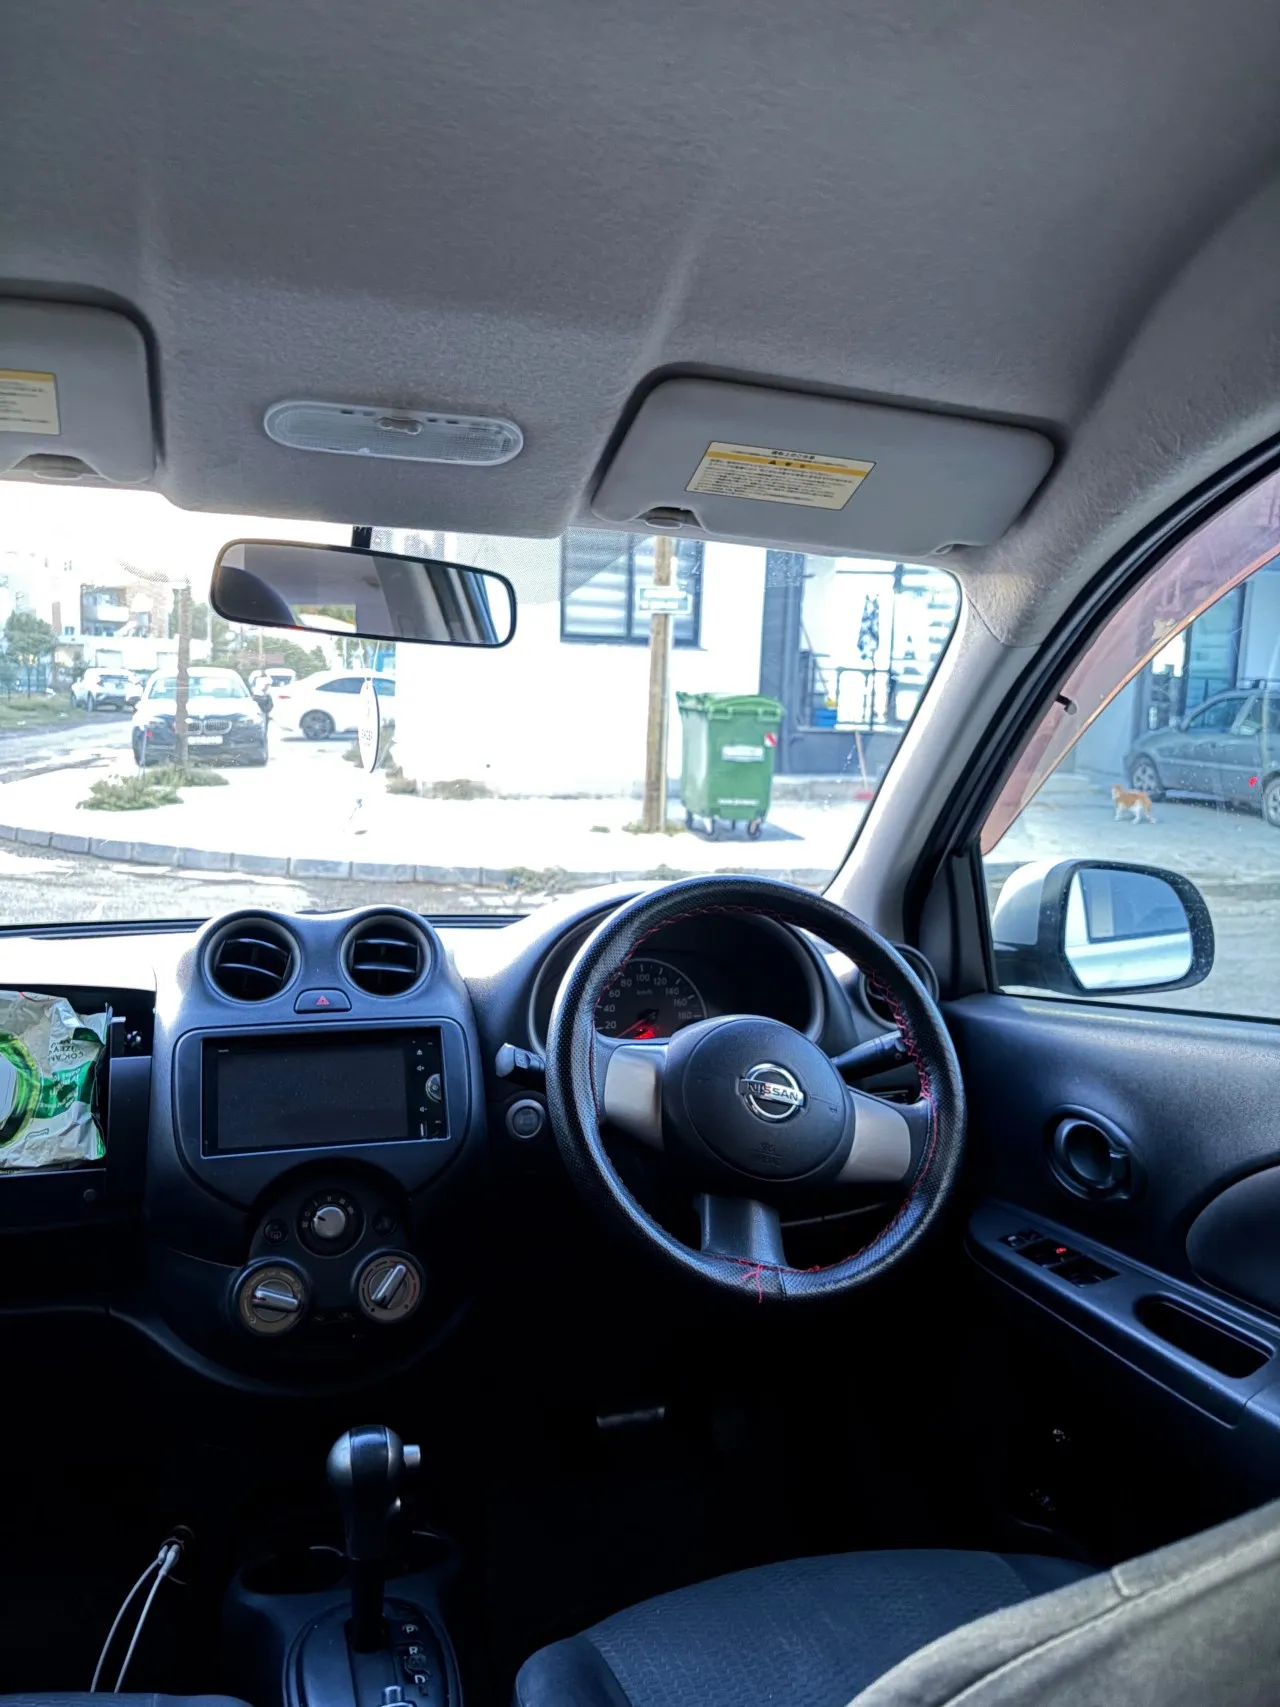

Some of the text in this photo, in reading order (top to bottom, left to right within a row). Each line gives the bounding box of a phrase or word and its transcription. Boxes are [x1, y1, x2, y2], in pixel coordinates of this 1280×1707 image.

[621, 978, 632, 987] 80
[636, 974, 650, 982] 100
[654, 978, 667, 986] 120
[665, 987, 679, 996] 140
[673, 998, 687, 1007] 160
[678, 1011, 692, 1020] 180
[749, 1083, 798, 1101] NISSAN
[409, 1646, 418, 1655] R
